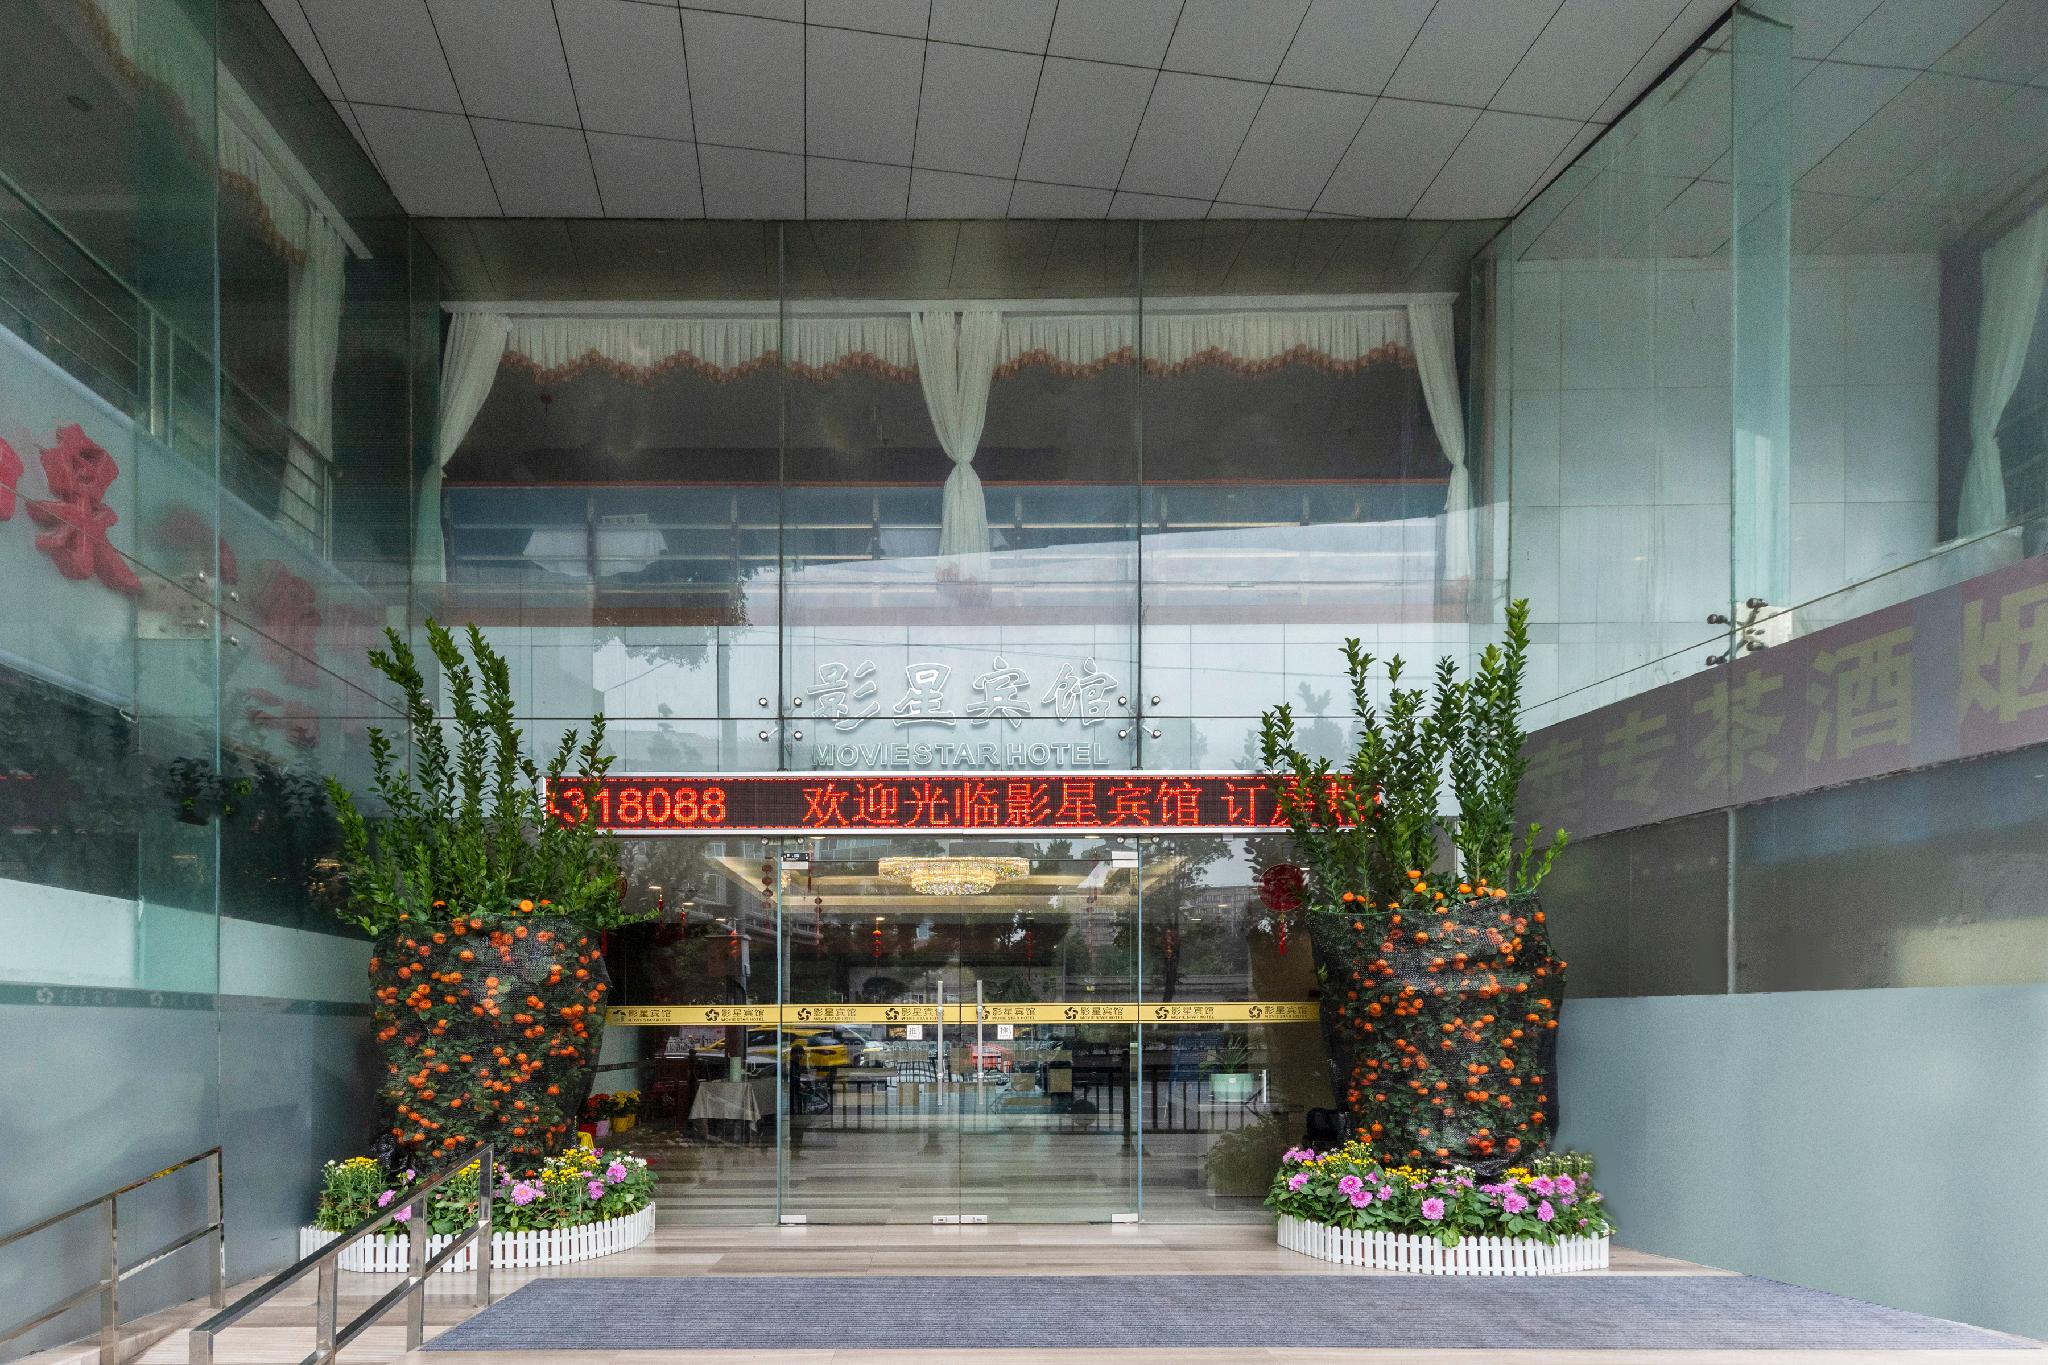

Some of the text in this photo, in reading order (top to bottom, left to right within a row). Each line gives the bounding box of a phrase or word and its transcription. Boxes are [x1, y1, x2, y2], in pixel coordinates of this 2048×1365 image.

[807, 655, 1119, 731] 影星宾馆
[812, 742, 1110, 768] MOVIESTAR HOTEL
[802, 782, 1203, 828] 欢迎光临影星宾馆
